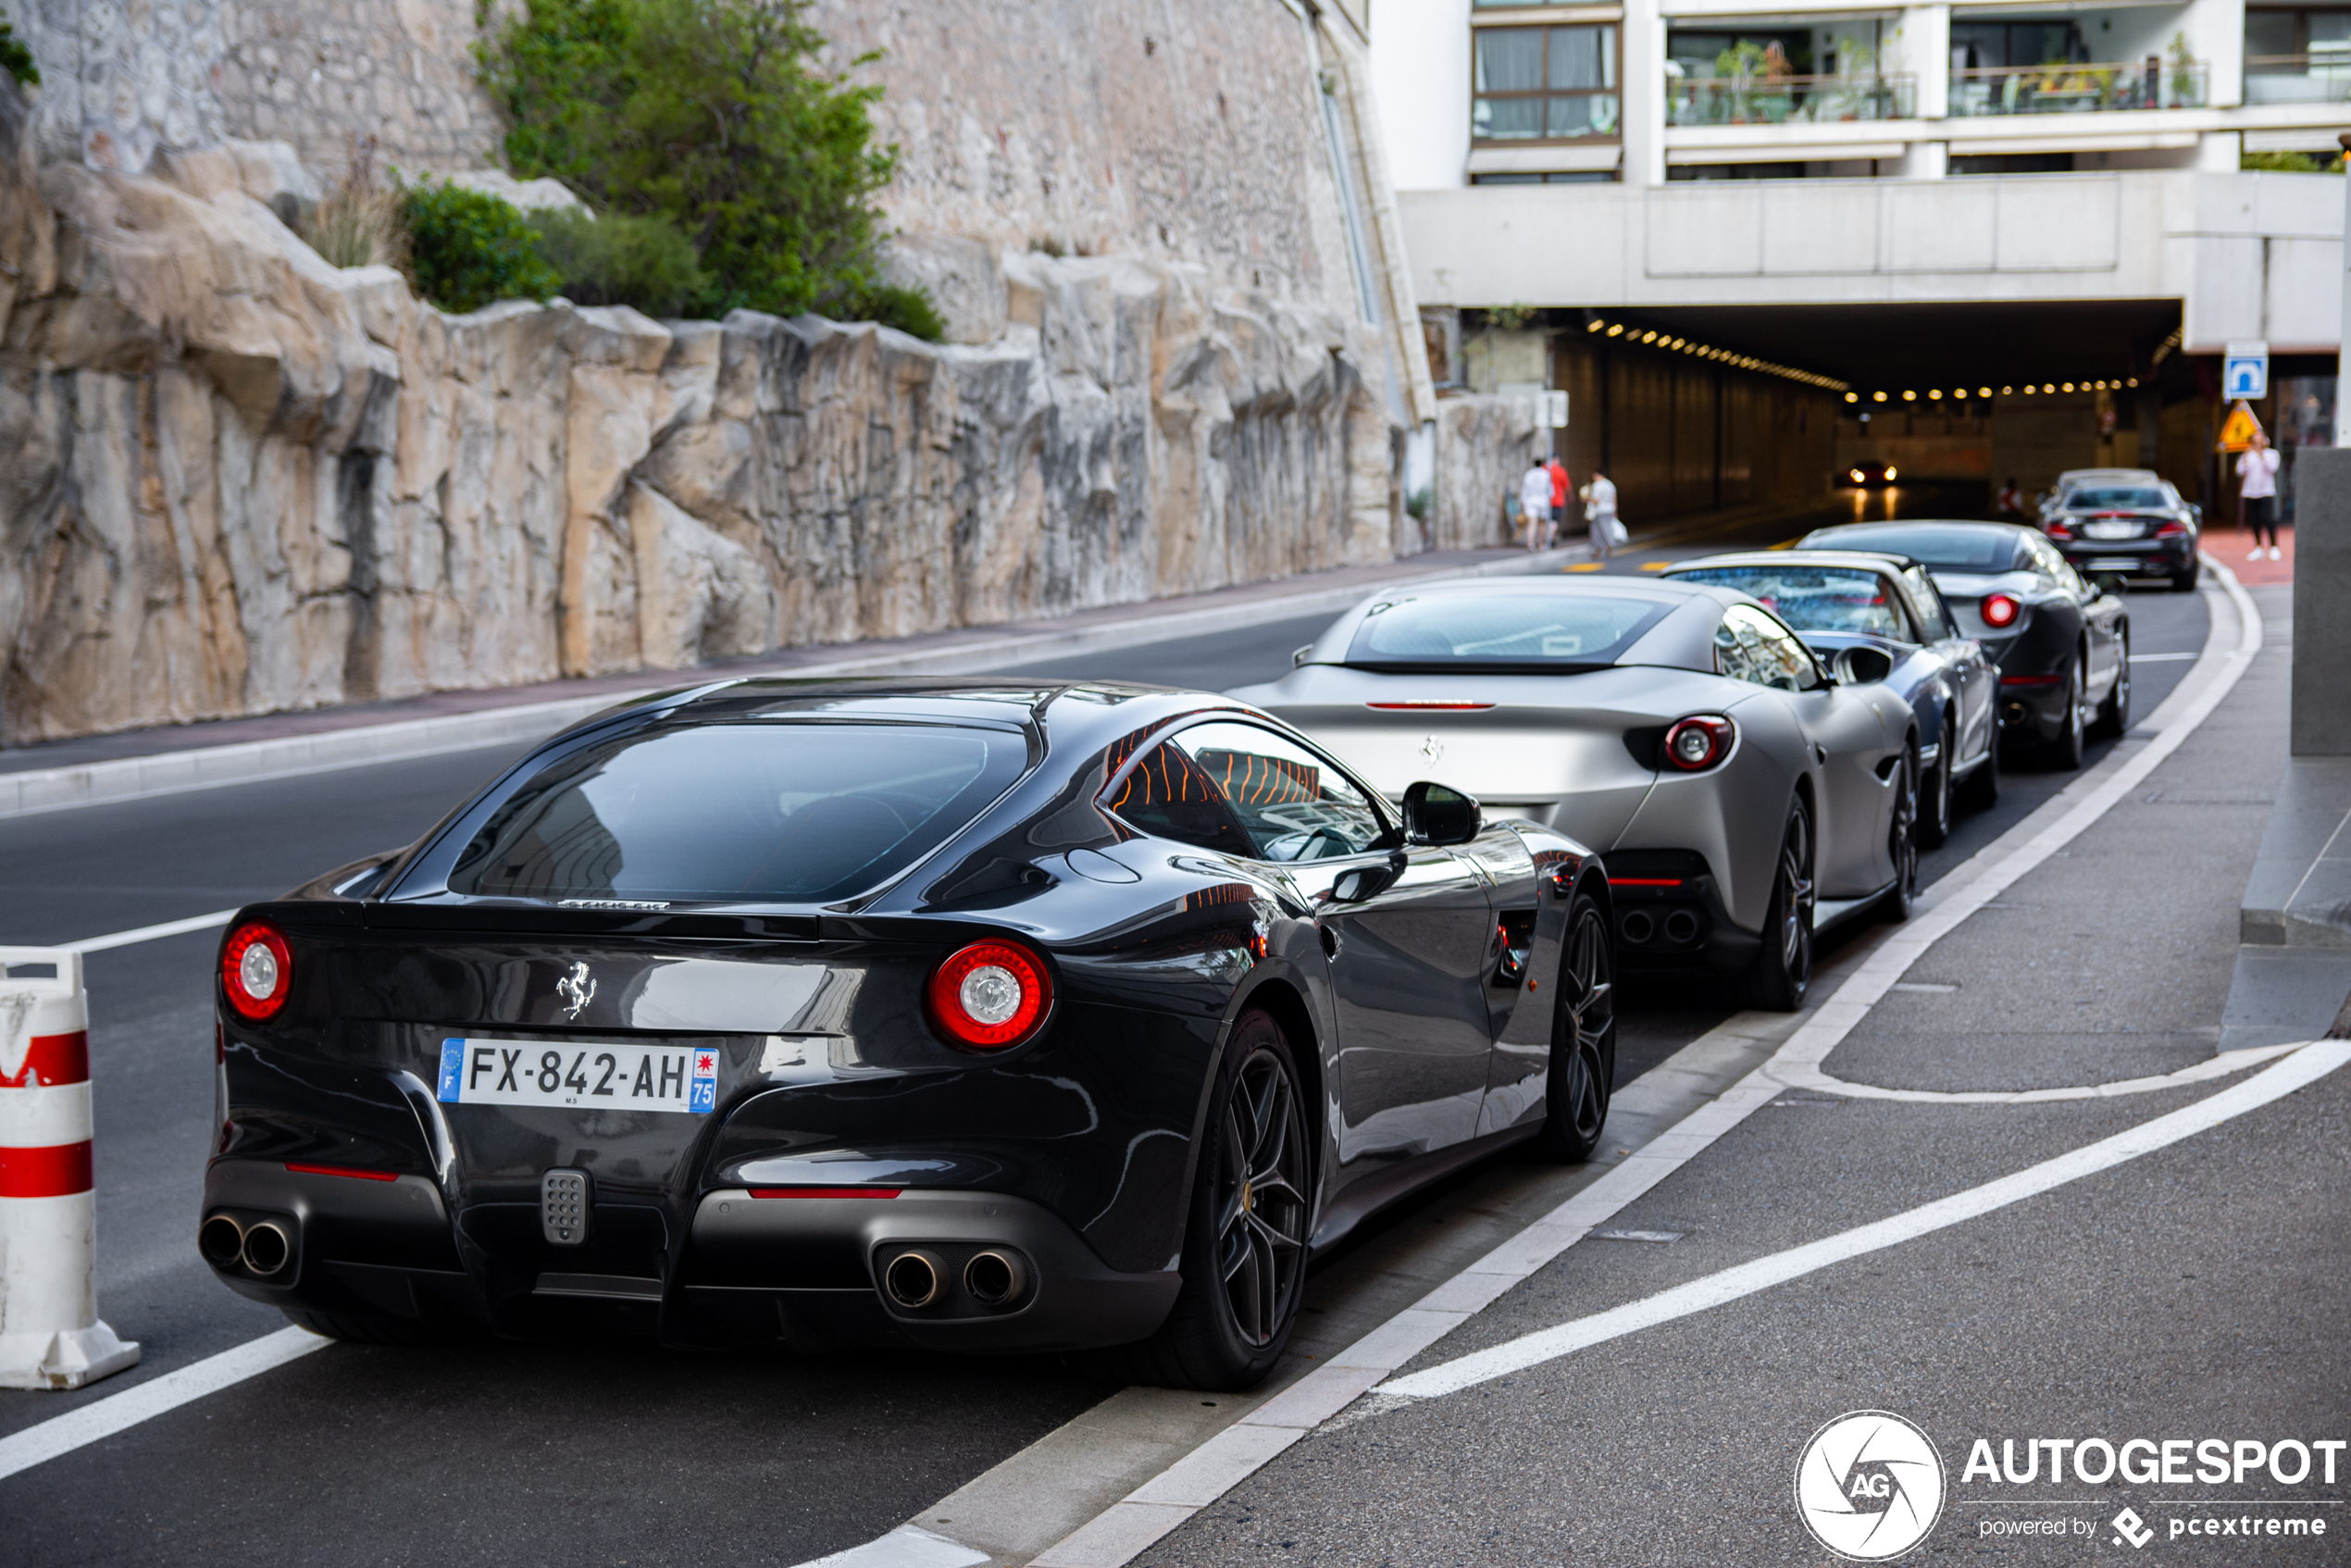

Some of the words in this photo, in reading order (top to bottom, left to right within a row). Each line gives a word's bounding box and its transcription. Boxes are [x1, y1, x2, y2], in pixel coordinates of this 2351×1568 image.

[444, 1076, 454, 1089] F
[469, 1048, 686, 1099] FX-842-AH
[693, 1083, 713, 1104] 75
